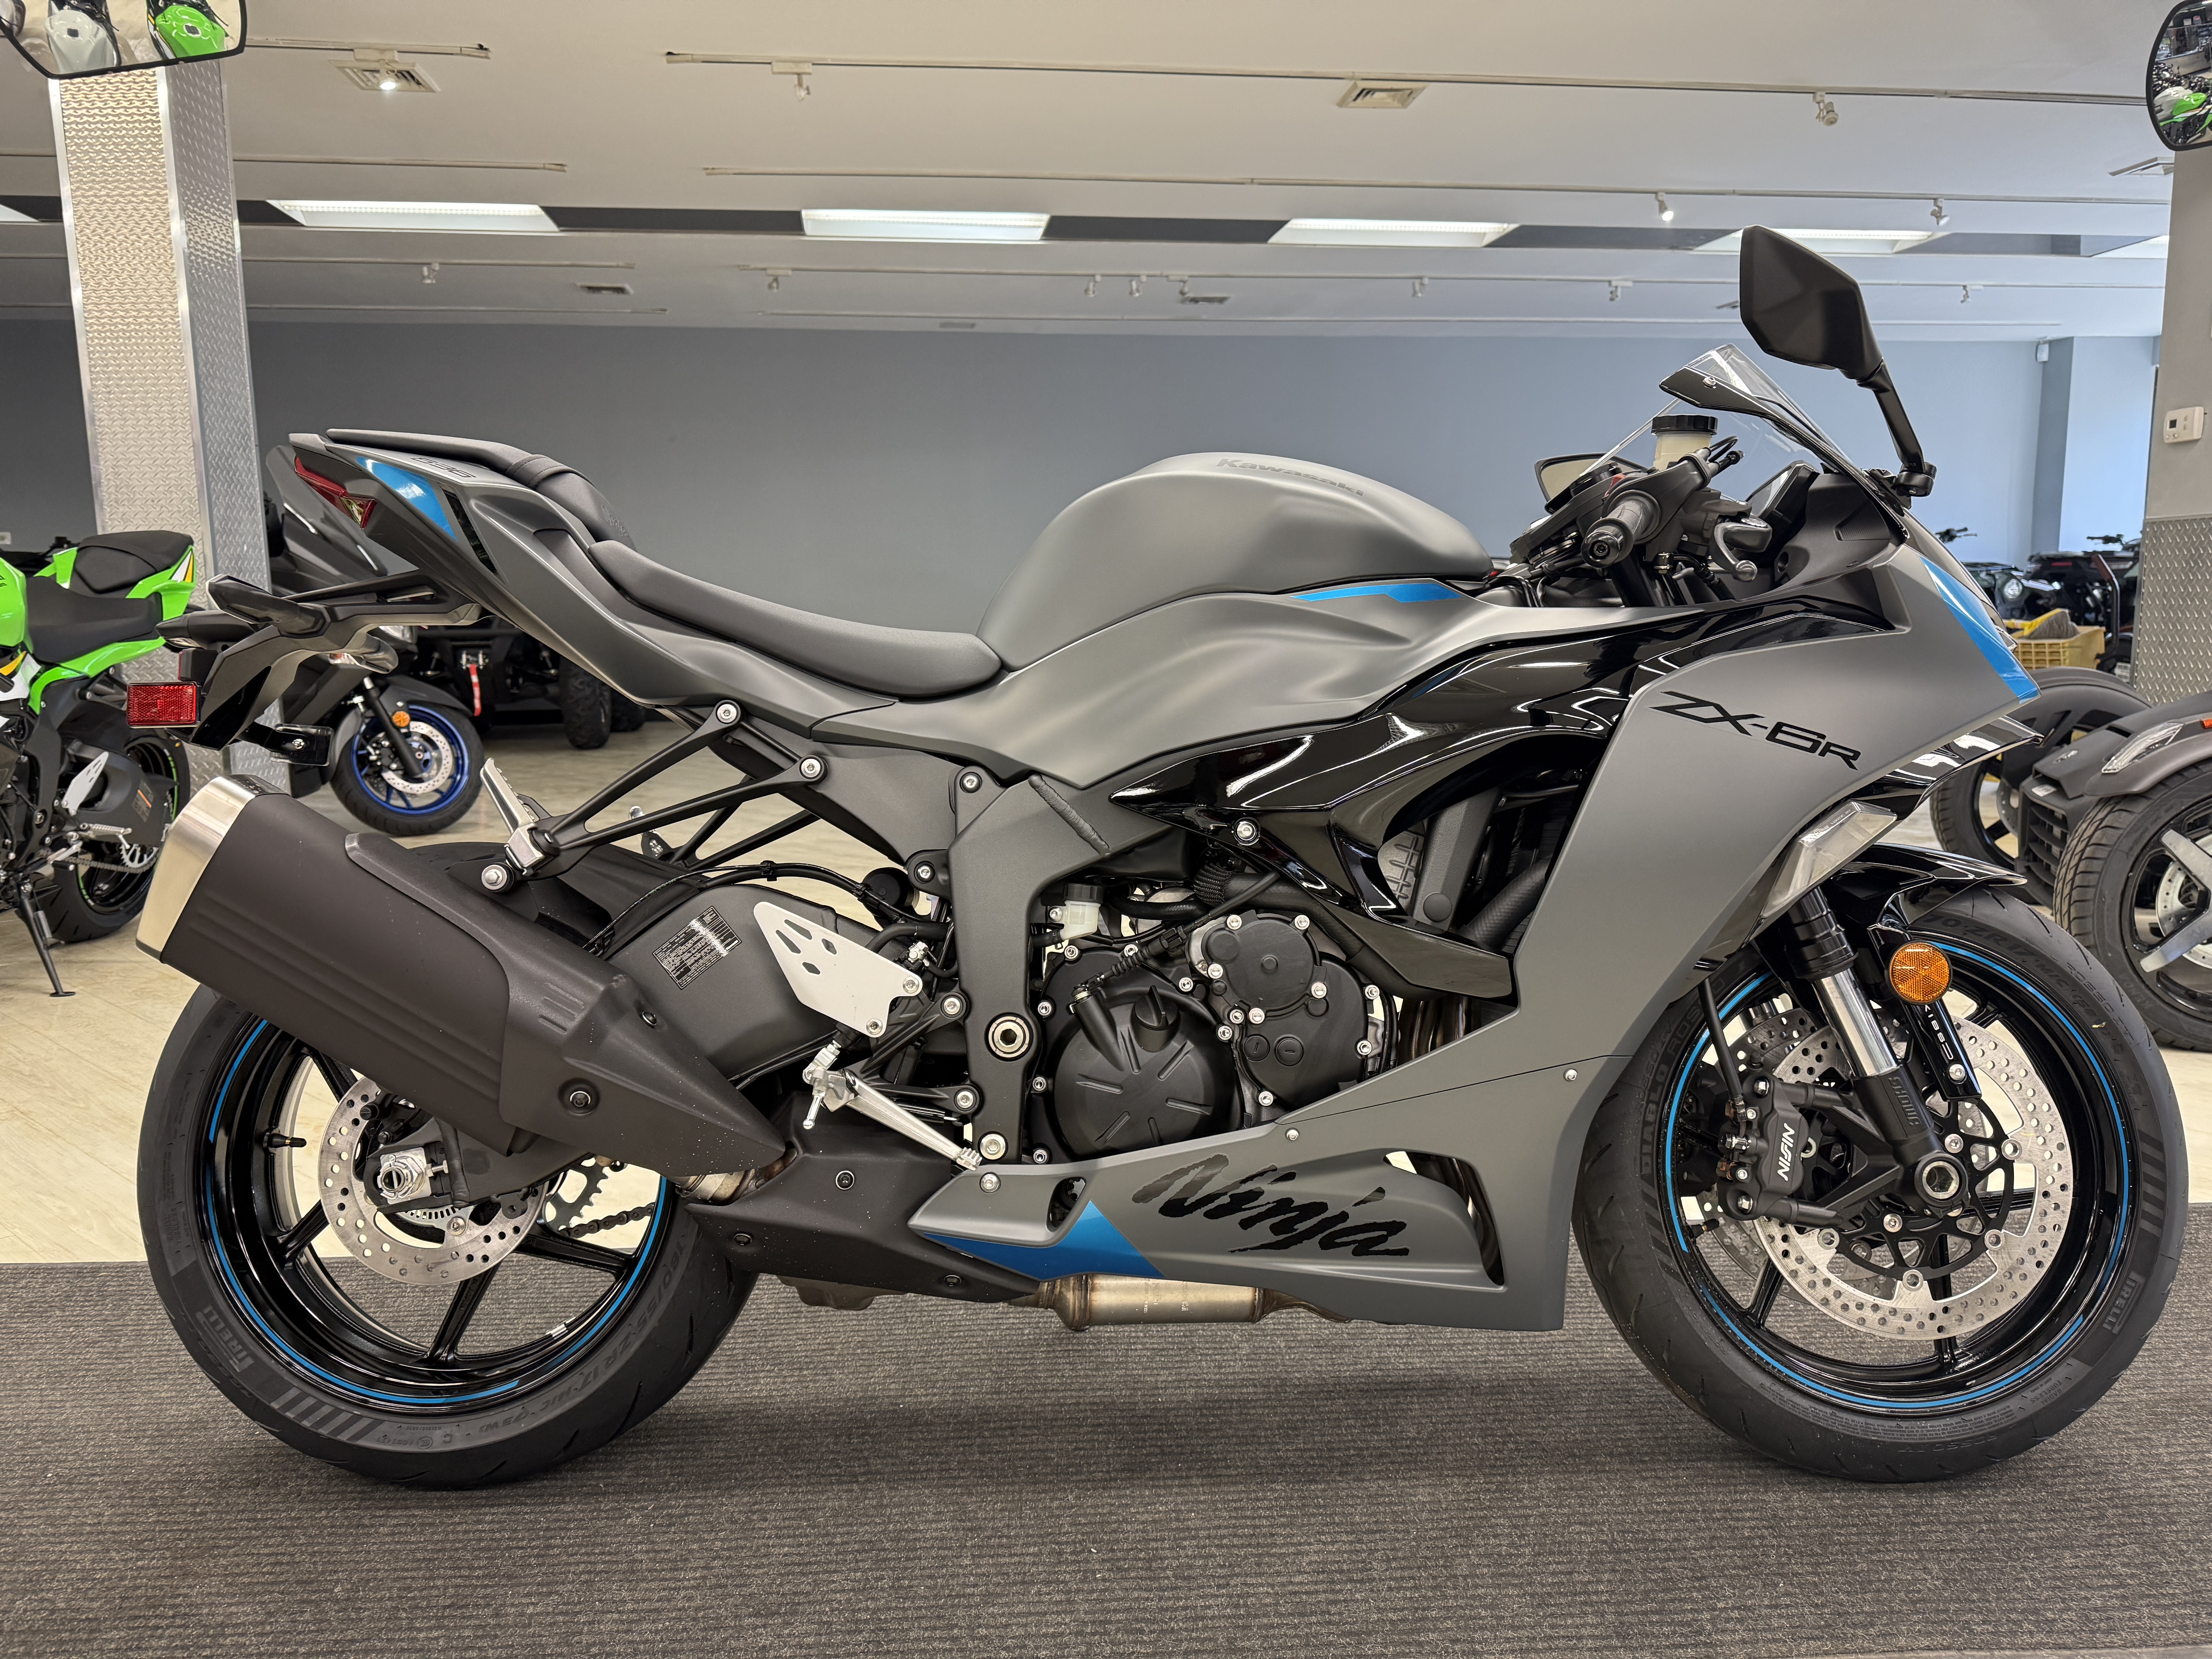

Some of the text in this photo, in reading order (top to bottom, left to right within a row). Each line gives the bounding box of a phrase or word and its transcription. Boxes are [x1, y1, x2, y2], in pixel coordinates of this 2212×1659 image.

[1216, 459, 1364, 497] Kawasaki
[1649, 691, 1862, 771] ZX-6R
[1665, 977, 1726, 1056] ROSO
[2064, 962, 2114, 1015] ROSSO
[1888, 1077, 1922, 1126] SHOWA
[1777, 1123, 1795, 1182] NISSIN
[1132, 1153, 1410, 1257] Ninja
[2101, 1270, 2147, 1335] PIRELLI
[195, 1304, 254, 1372] PIRELLI
